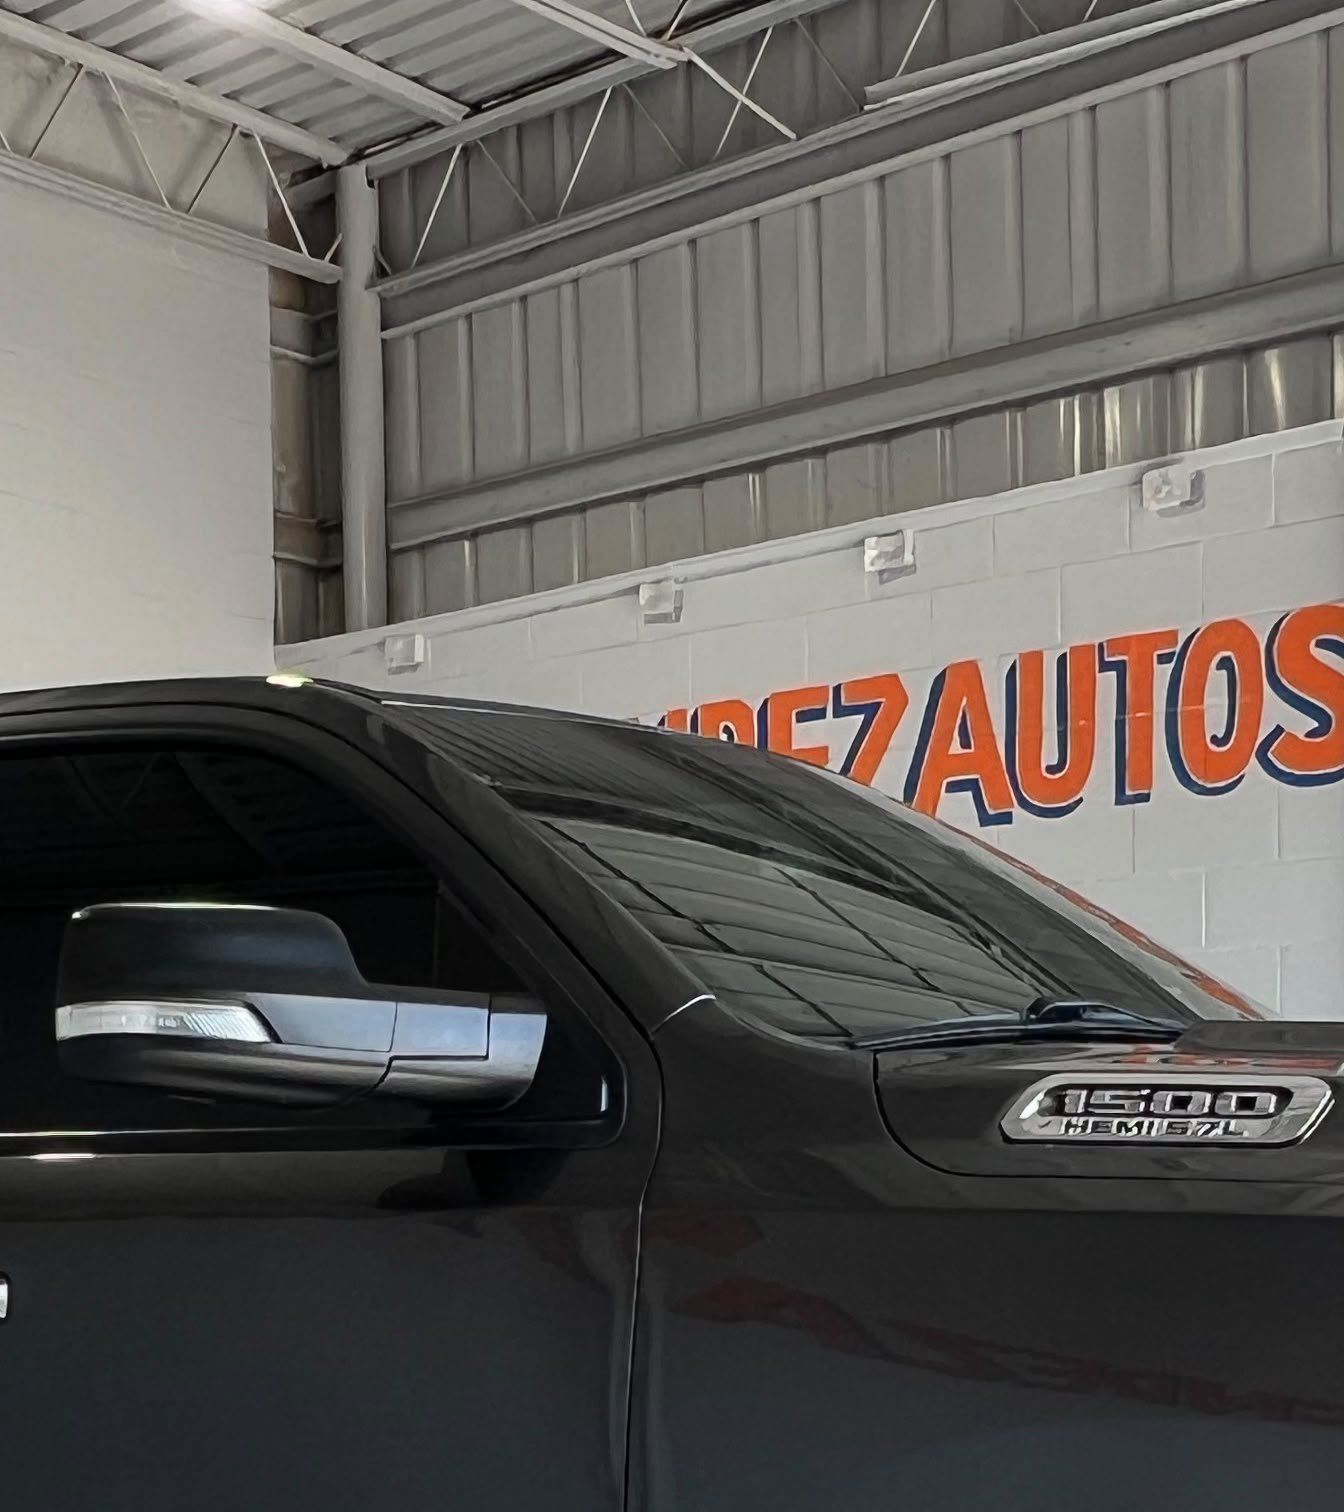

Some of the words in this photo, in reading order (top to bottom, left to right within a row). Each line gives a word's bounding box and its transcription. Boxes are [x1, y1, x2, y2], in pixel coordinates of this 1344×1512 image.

[1060, 1087, 1278, 1114] 1500
[1059, 1118, 1159, 1137] HEMI
[1161, 1118, 1250, 1137] 57L
